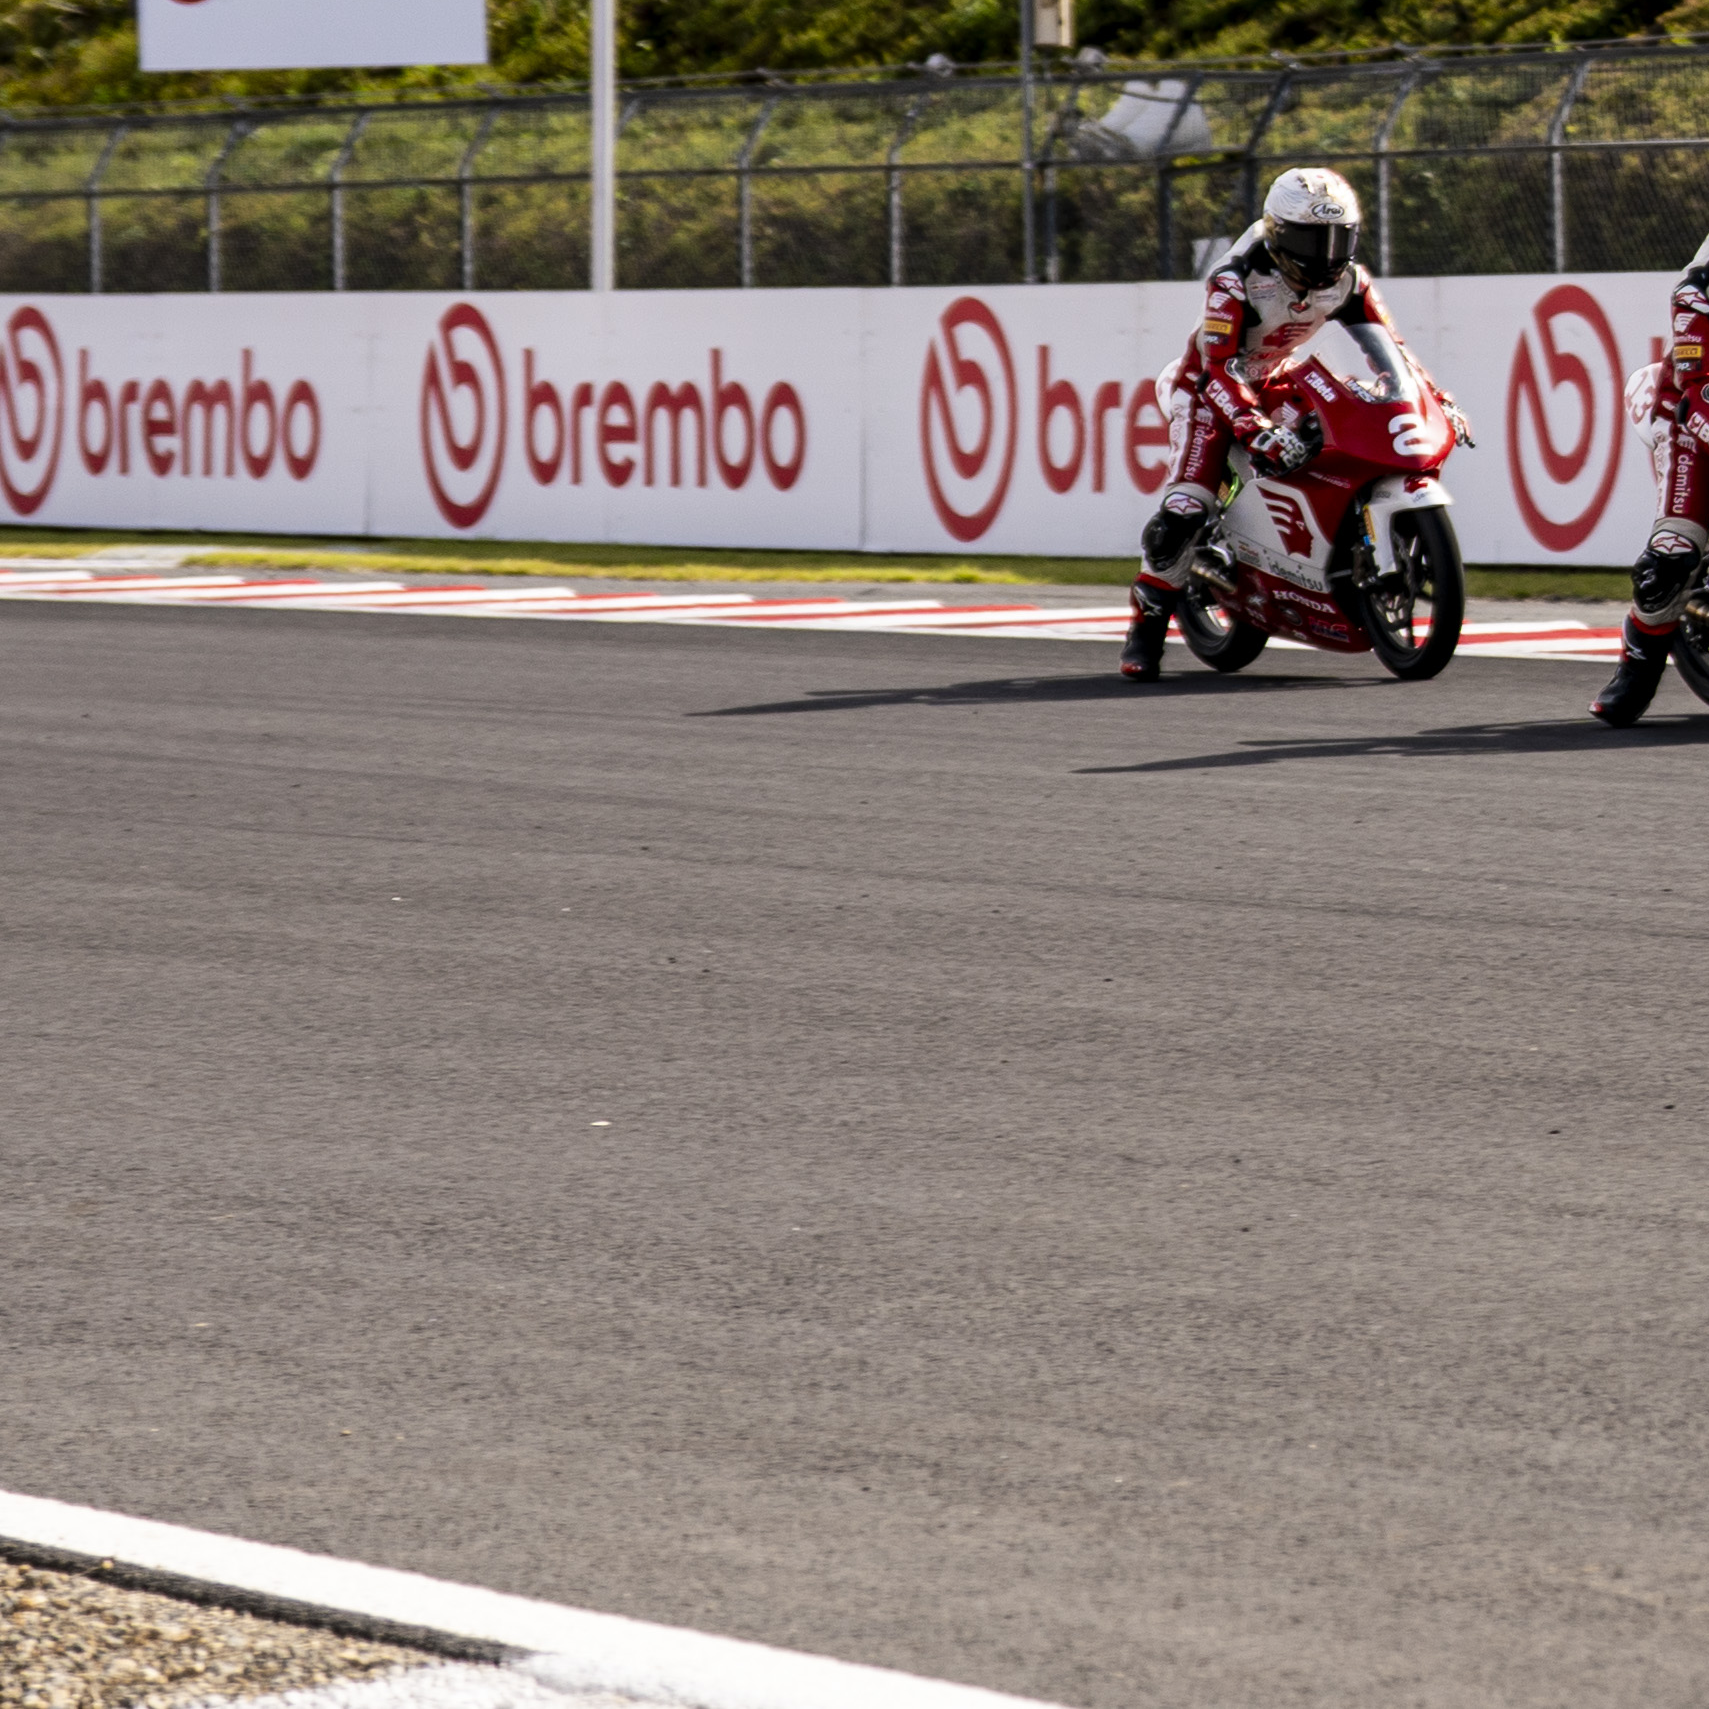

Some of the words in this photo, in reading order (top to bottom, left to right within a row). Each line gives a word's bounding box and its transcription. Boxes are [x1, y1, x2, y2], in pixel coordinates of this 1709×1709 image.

[78, 347, 321, 480] brembo
[1311, 376, 1337, 403] Beta
[522, 347, 807, 491] brembo
[1037, 344, 1171, 495] bre
[1388, 413, 1434, 456] 2
[1671, 452, 1692, 515] demitsu
[1267, 556, 1324, 592] idemitsu
[1272, 589, 1336, 615] HONDA
